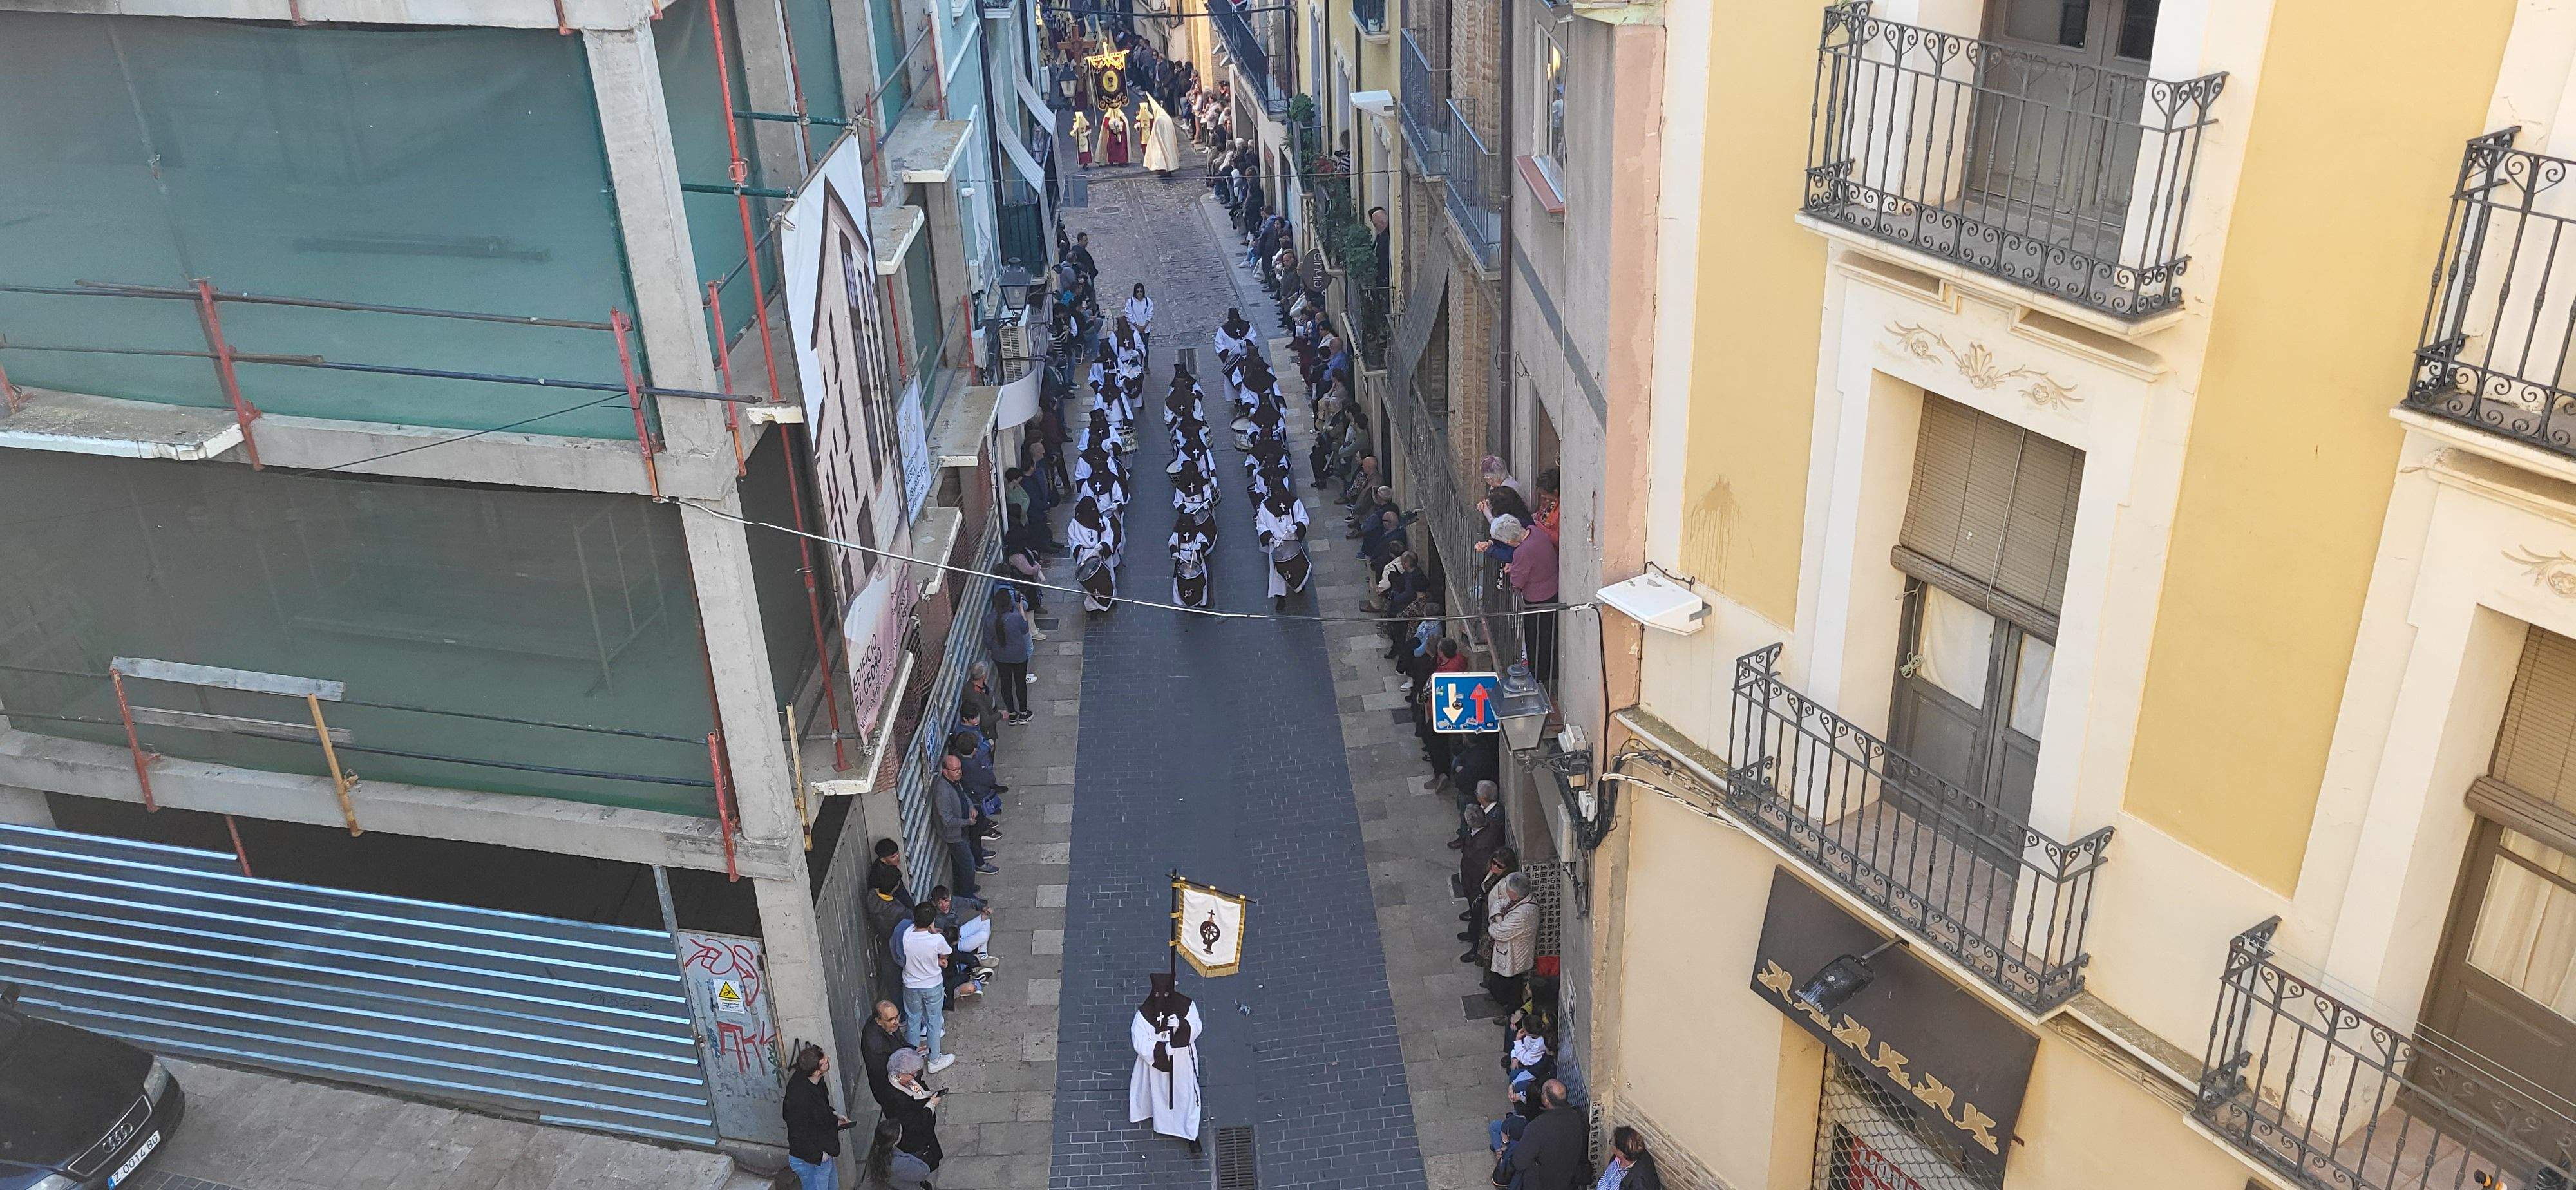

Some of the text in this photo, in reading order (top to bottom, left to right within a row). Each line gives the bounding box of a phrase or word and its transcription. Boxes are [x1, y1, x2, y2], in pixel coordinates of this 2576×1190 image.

[853, 633, 877, 693] EDIFICIO
[855, 646, 882, 713] EL CEDRO
[146, 1134, 158, 1150] BG
